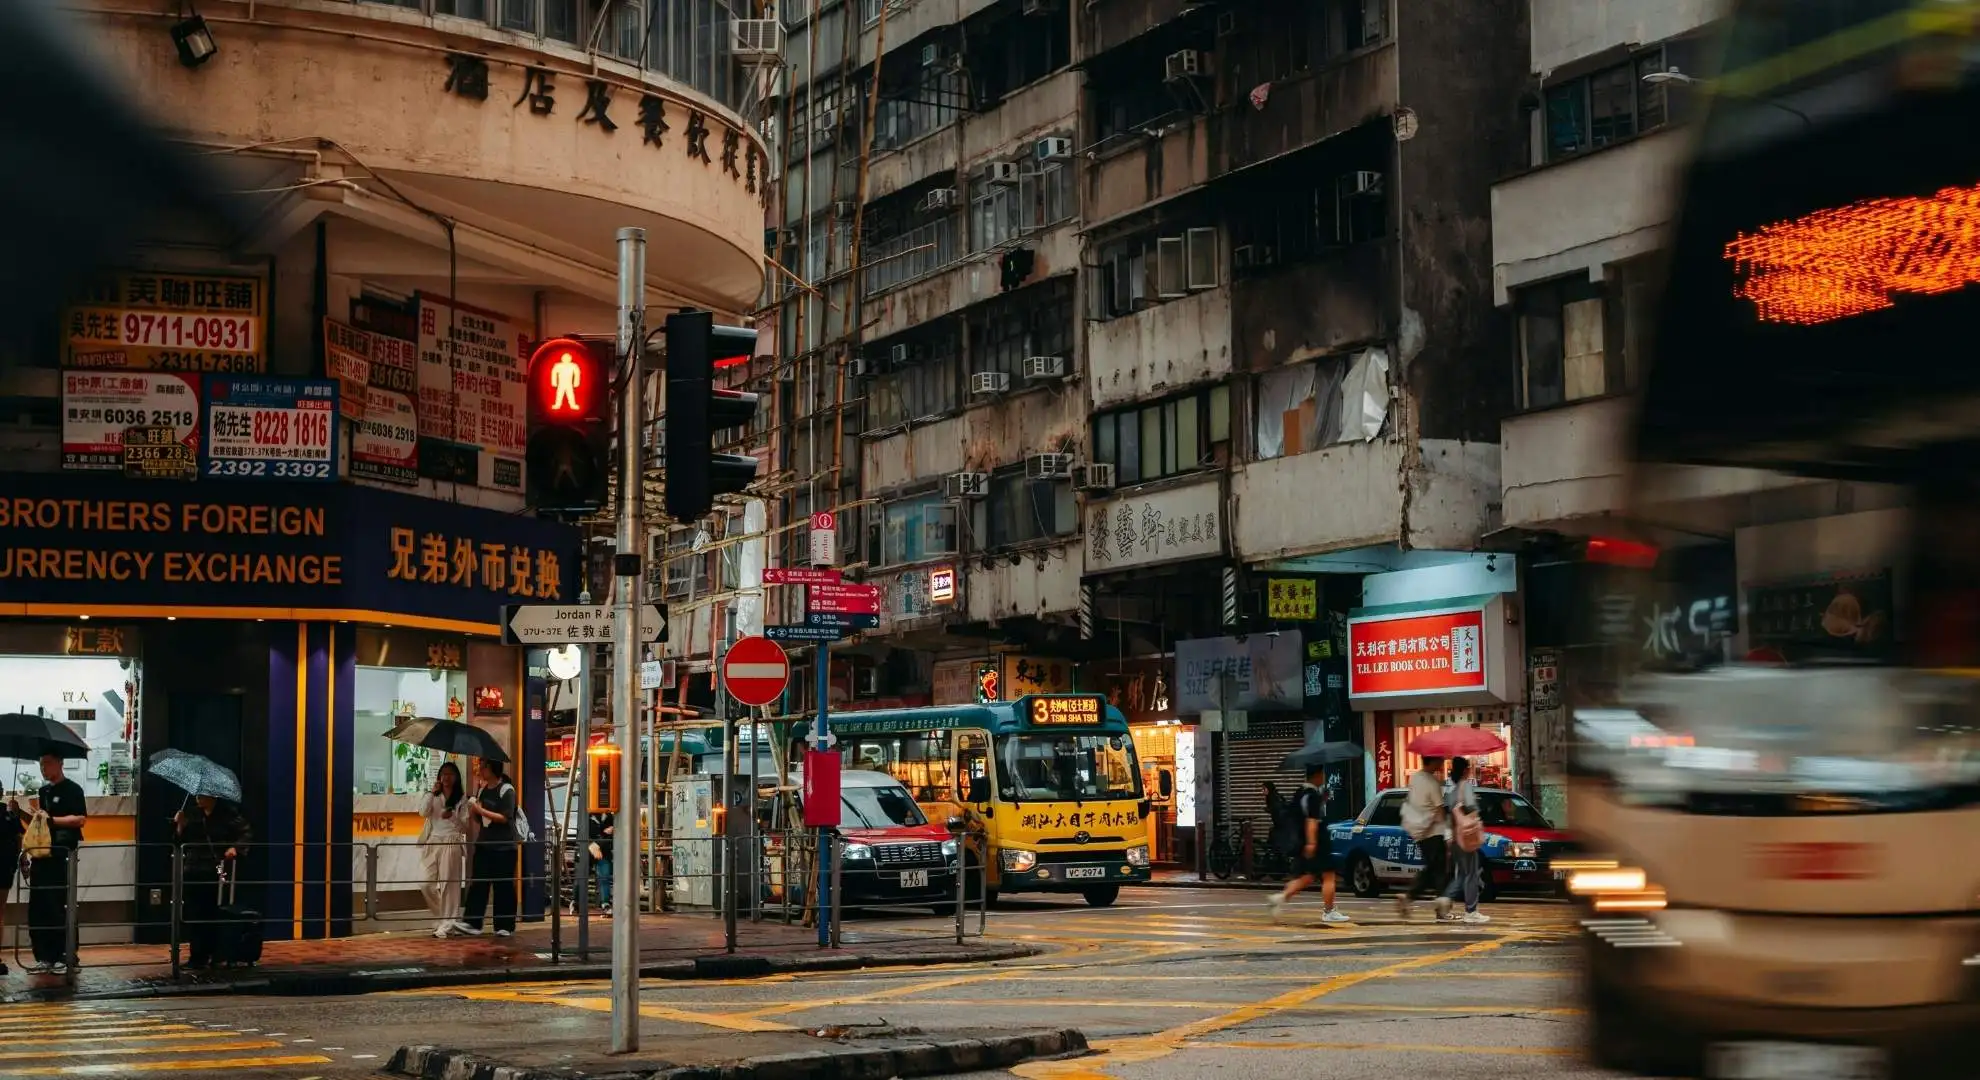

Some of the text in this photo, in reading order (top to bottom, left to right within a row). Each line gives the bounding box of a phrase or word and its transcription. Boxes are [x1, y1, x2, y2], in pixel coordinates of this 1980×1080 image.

[125, 313, 250, 349] 9711-0931
[160, 352, 254, 372] 2311-7368
[105, 409, 146, 424] 6036
[152, 411, 192, 426] 2518
[254, 411, 289, 445] 8228
[294, 412, 327, 446] 1816
[371, 421, 415, 443] 6036 2518
[128, 448, 160, 459] 2366
[208, 460, 330, 478] 2392 3392
[182, 503, 325, 537] FOREIGN
[164, 551, 343, 585] EXCHANGE
[555, 609, 615, 620] Jordan Ra
[566, 624, 611, 638] 佐敦道
[1356, 635, 1450, 657] 天利行書局有限公司
[1356, 657, 1450, 674] T.H. LEE BOOK CO. LTD.
[1034, 698, 1049, 723] 3
[1051, 713, 1098, 723] TSIM SHA TSUI
[1069, 868, 1102, 877] VC 2974
[903, 878, 924, 886] 7701
